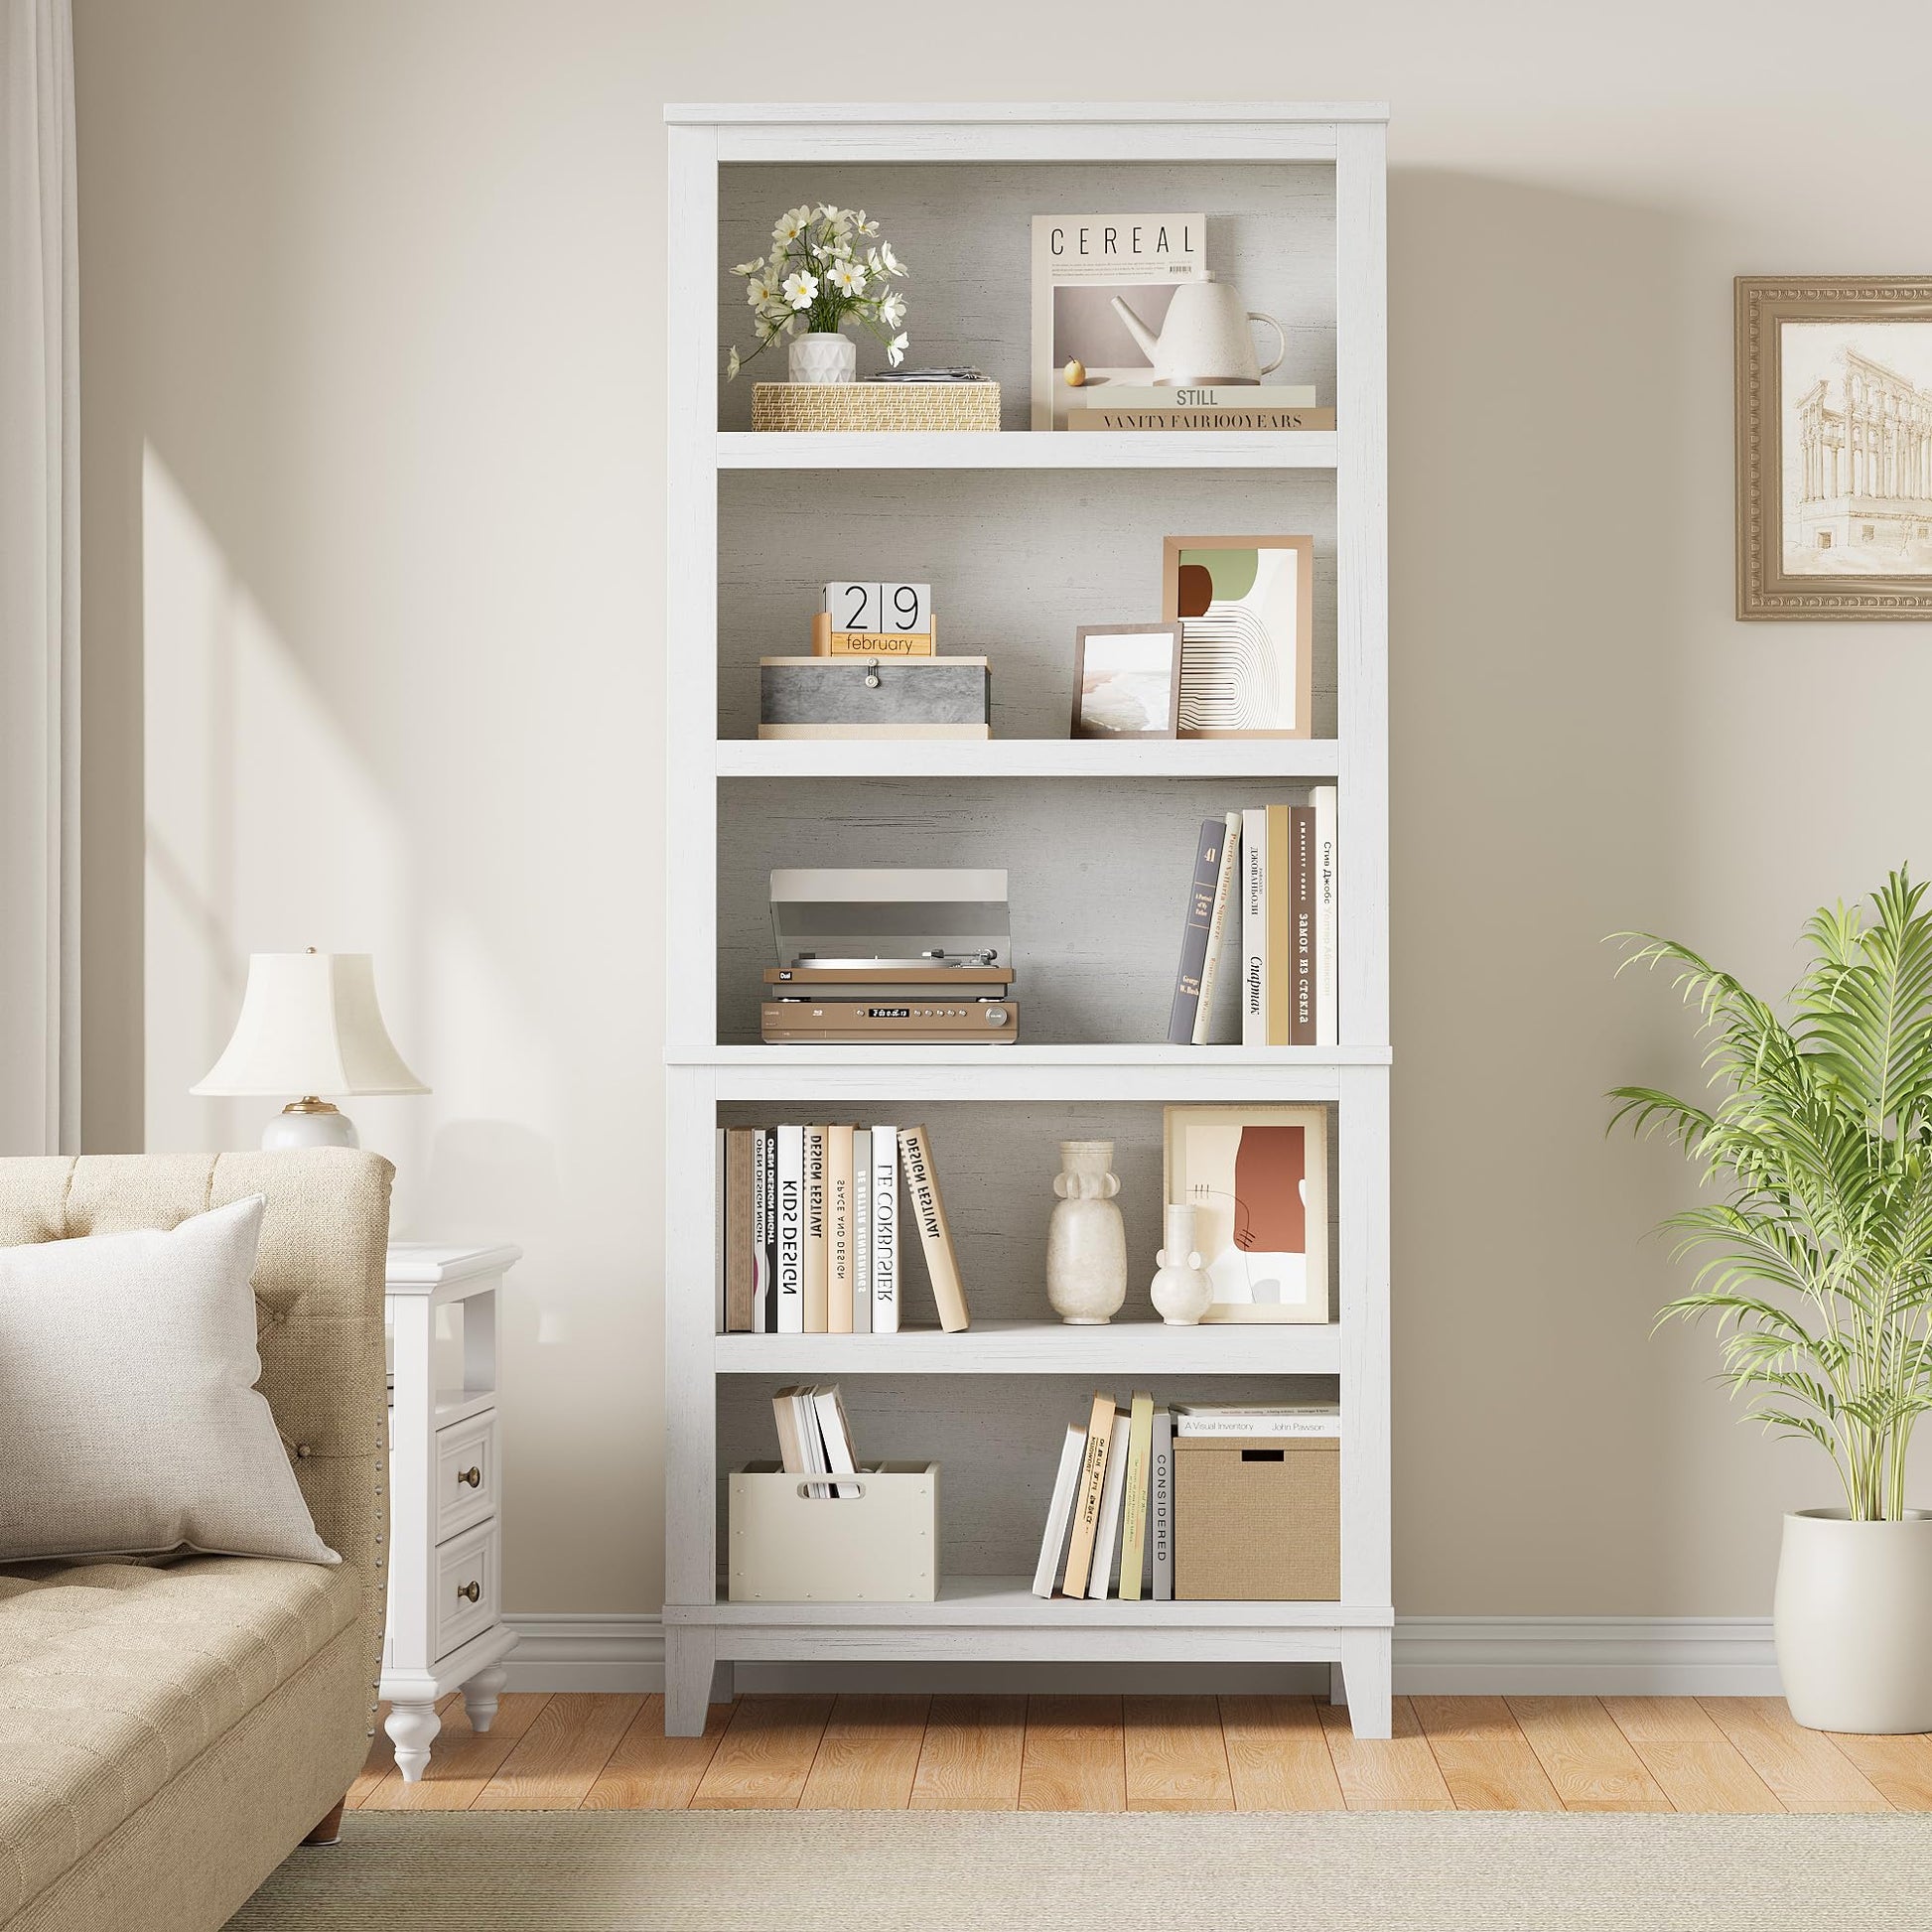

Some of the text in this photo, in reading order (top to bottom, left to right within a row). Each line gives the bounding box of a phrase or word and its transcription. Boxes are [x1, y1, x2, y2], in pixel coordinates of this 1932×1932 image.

[1050, 226, 1194, 256] CEREAL
[1176, 389, 1218, 406] STILL
[1104, 415, 1168, 428] VANITY
[847, 633, 912, 655] february
[1323, 869, 1332, 904] Джобс
[1300, 959, 1309, 974] из
[1247, 956, 1263, 1015] Спартак
[1300, 979, 1309, 1023] стекла
[1218, 1422, 1254, 1431] Inventory
[1157, 1453, 1167, 1562] CONSIDERED
